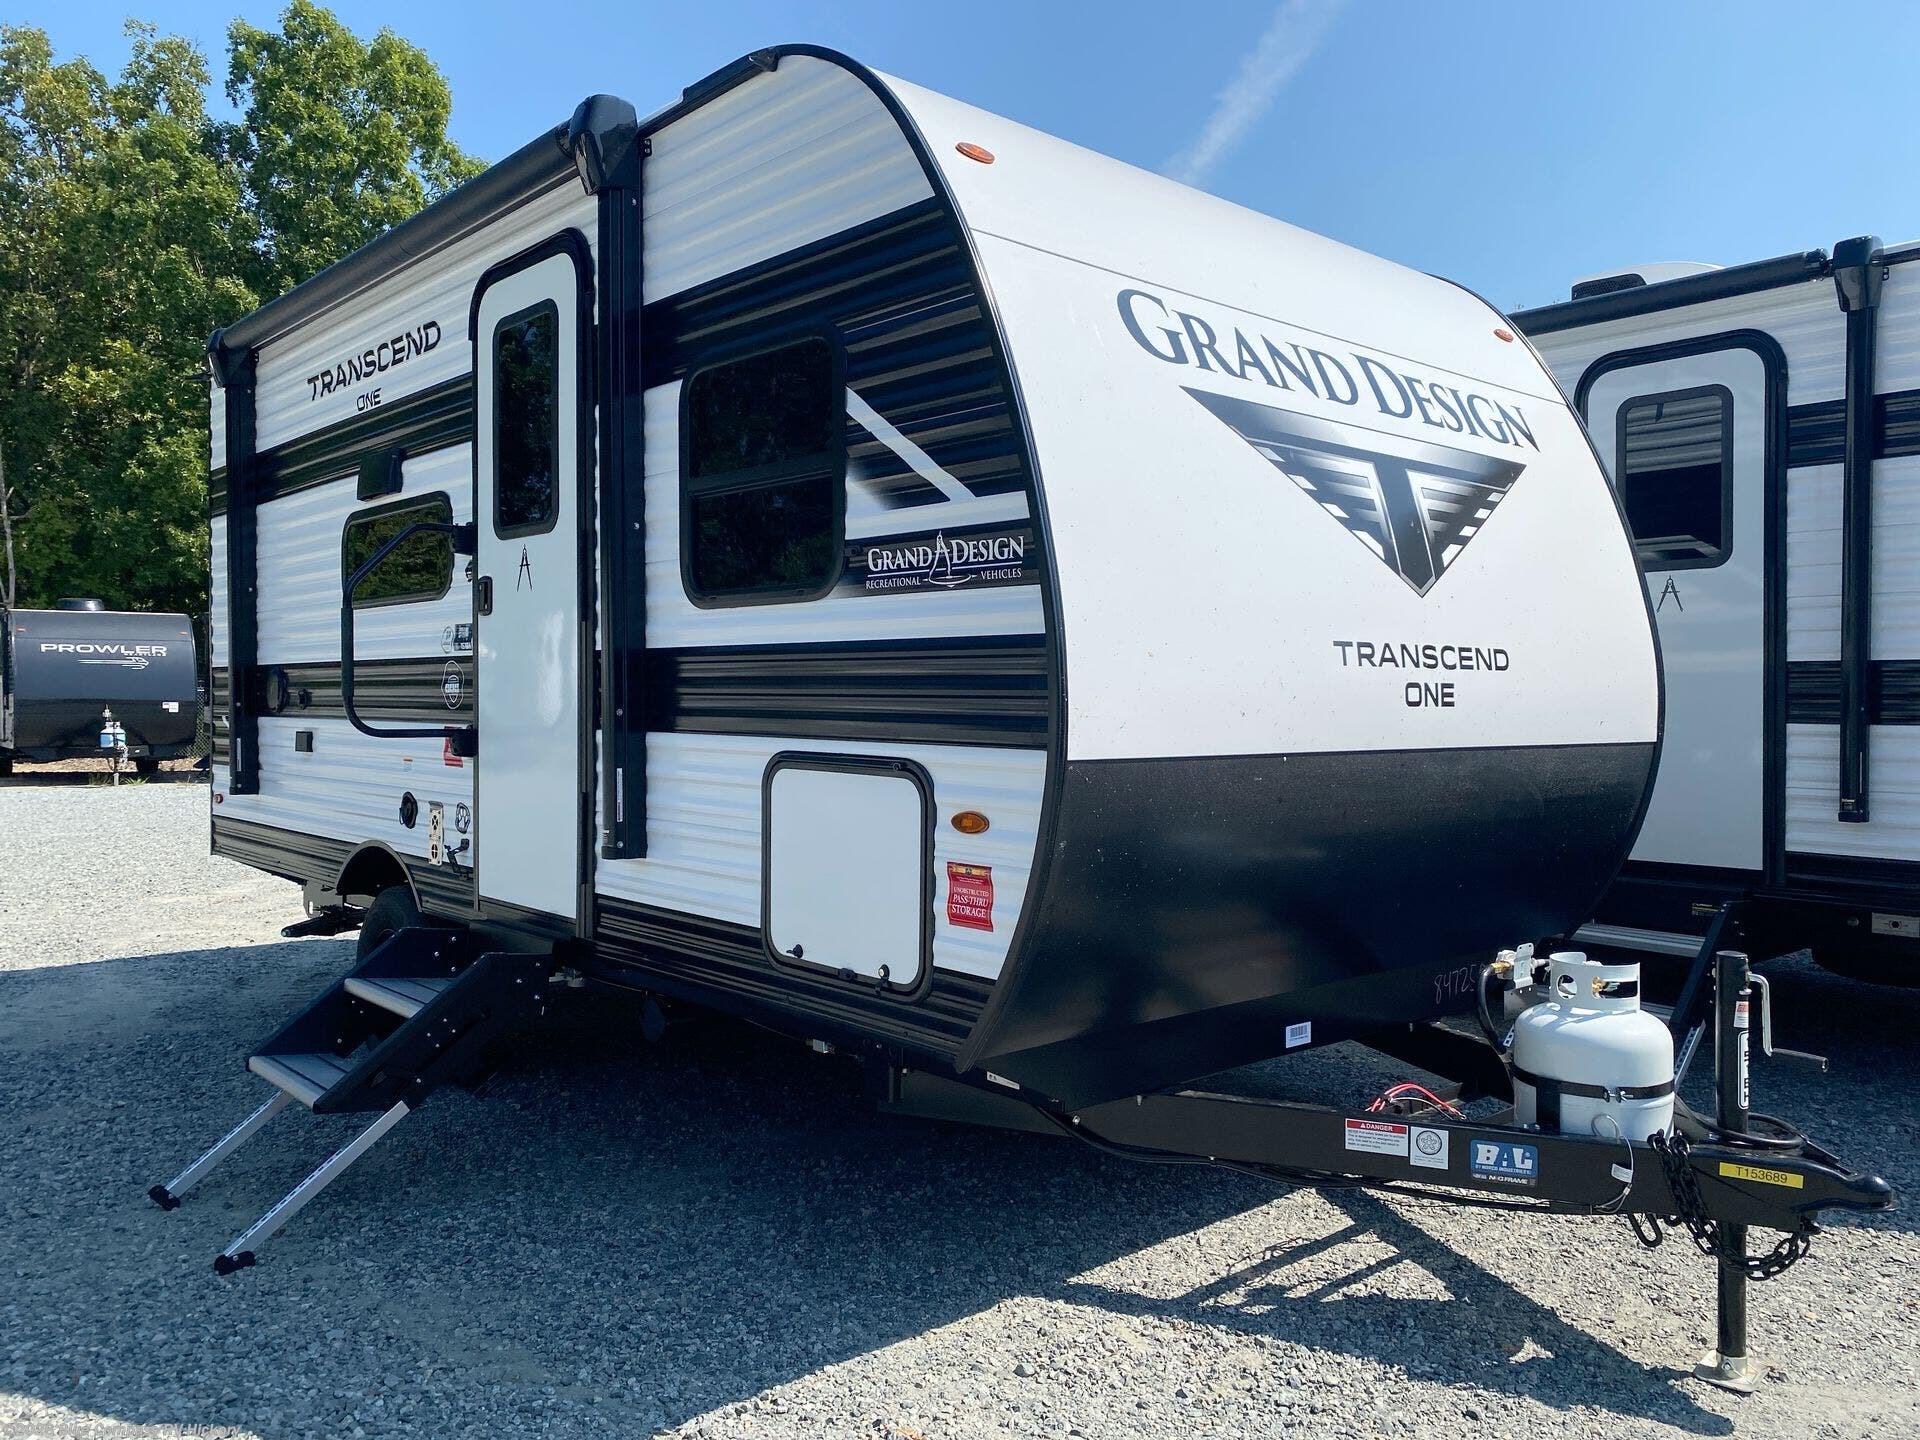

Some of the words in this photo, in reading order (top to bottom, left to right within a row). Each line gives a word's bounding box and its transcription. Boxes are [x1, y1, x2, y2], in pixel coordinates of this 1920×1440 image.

[307, 320, 441, 401] TRANSCEND
[1116, 288, 1359, 406] GRAND
[1350, 352, 1540, 452] DESIGN
[356, 388, 382, 412] ONE
[867, 546, 932, 572] GRAND
[949, 535, 1024, 564] DESIGN
[865, 576, 921, 590] RECREATIONAL
[981, 567, 1022, 580] VEHICLES
[40, 643, 168, 654] PROWLER
[1333, 640, 1510, 672] TRANSCEND
[1405, 681, 1455, 707] ONE
[951, 904, 987, 918] STORAGE
[1366, 1122, 1393, 1132] DANGER
[1736, 1166, 1788, 1184] T153689
